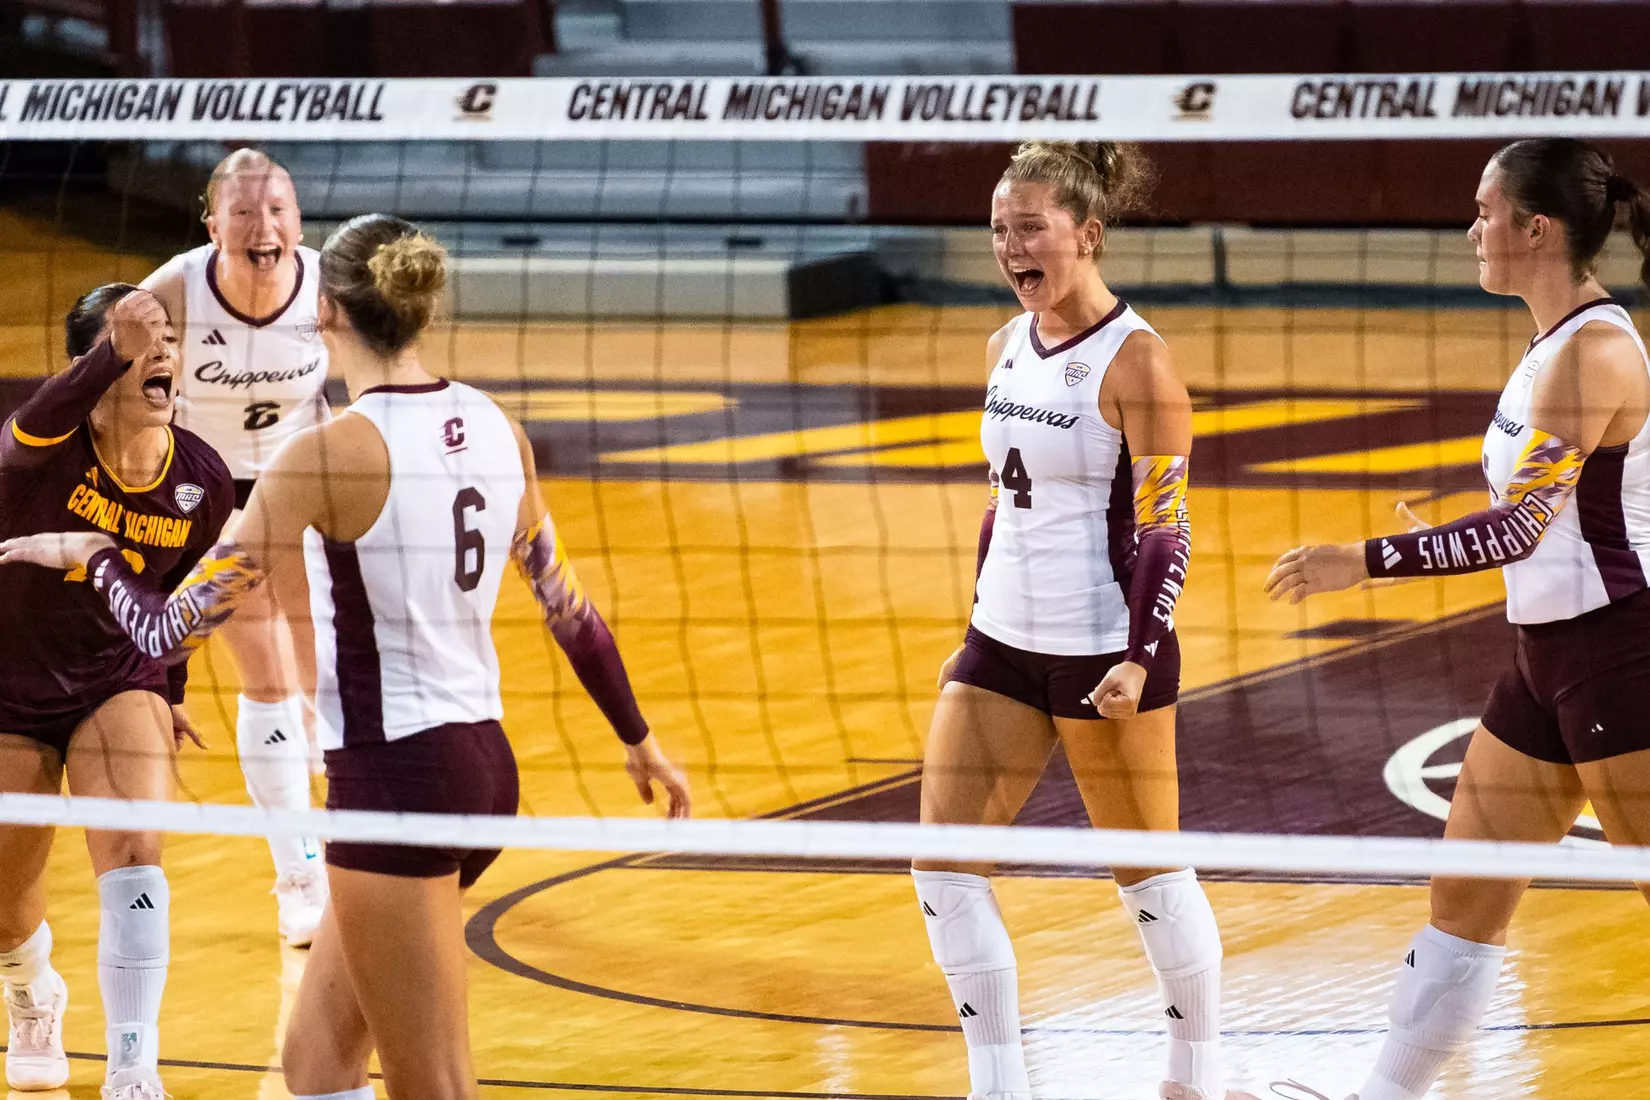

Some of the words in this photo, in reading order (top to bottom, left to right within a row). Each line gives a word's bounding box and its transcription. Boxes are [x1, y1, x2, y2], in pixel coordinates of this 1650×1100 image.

[19, 84, 184, 122] MICHIGAN
[190, 83, 386, 121] VOLLEYBALL
[456, 84, 497, 115] C
[567, 83, 710, 120] CENTRAL
[721, 83, 893, 120] MICHIGAN
[900, 83, 1101, 120] VOLLEYBALL
[1175, 82, 1216, 113] C
[1290, 81, 1437, 118] CENTRAL
[1451, 79, 1626, 118] MICHIGAN
[443, 417, 467, 447] C
[1001, 447, 1032, 509] 4
[452, 486, 486, 592] 6
[1418, 493, 1554, 570] CHIPPEWAS
[109, 579, 203, 659] CHIPPEWAS
